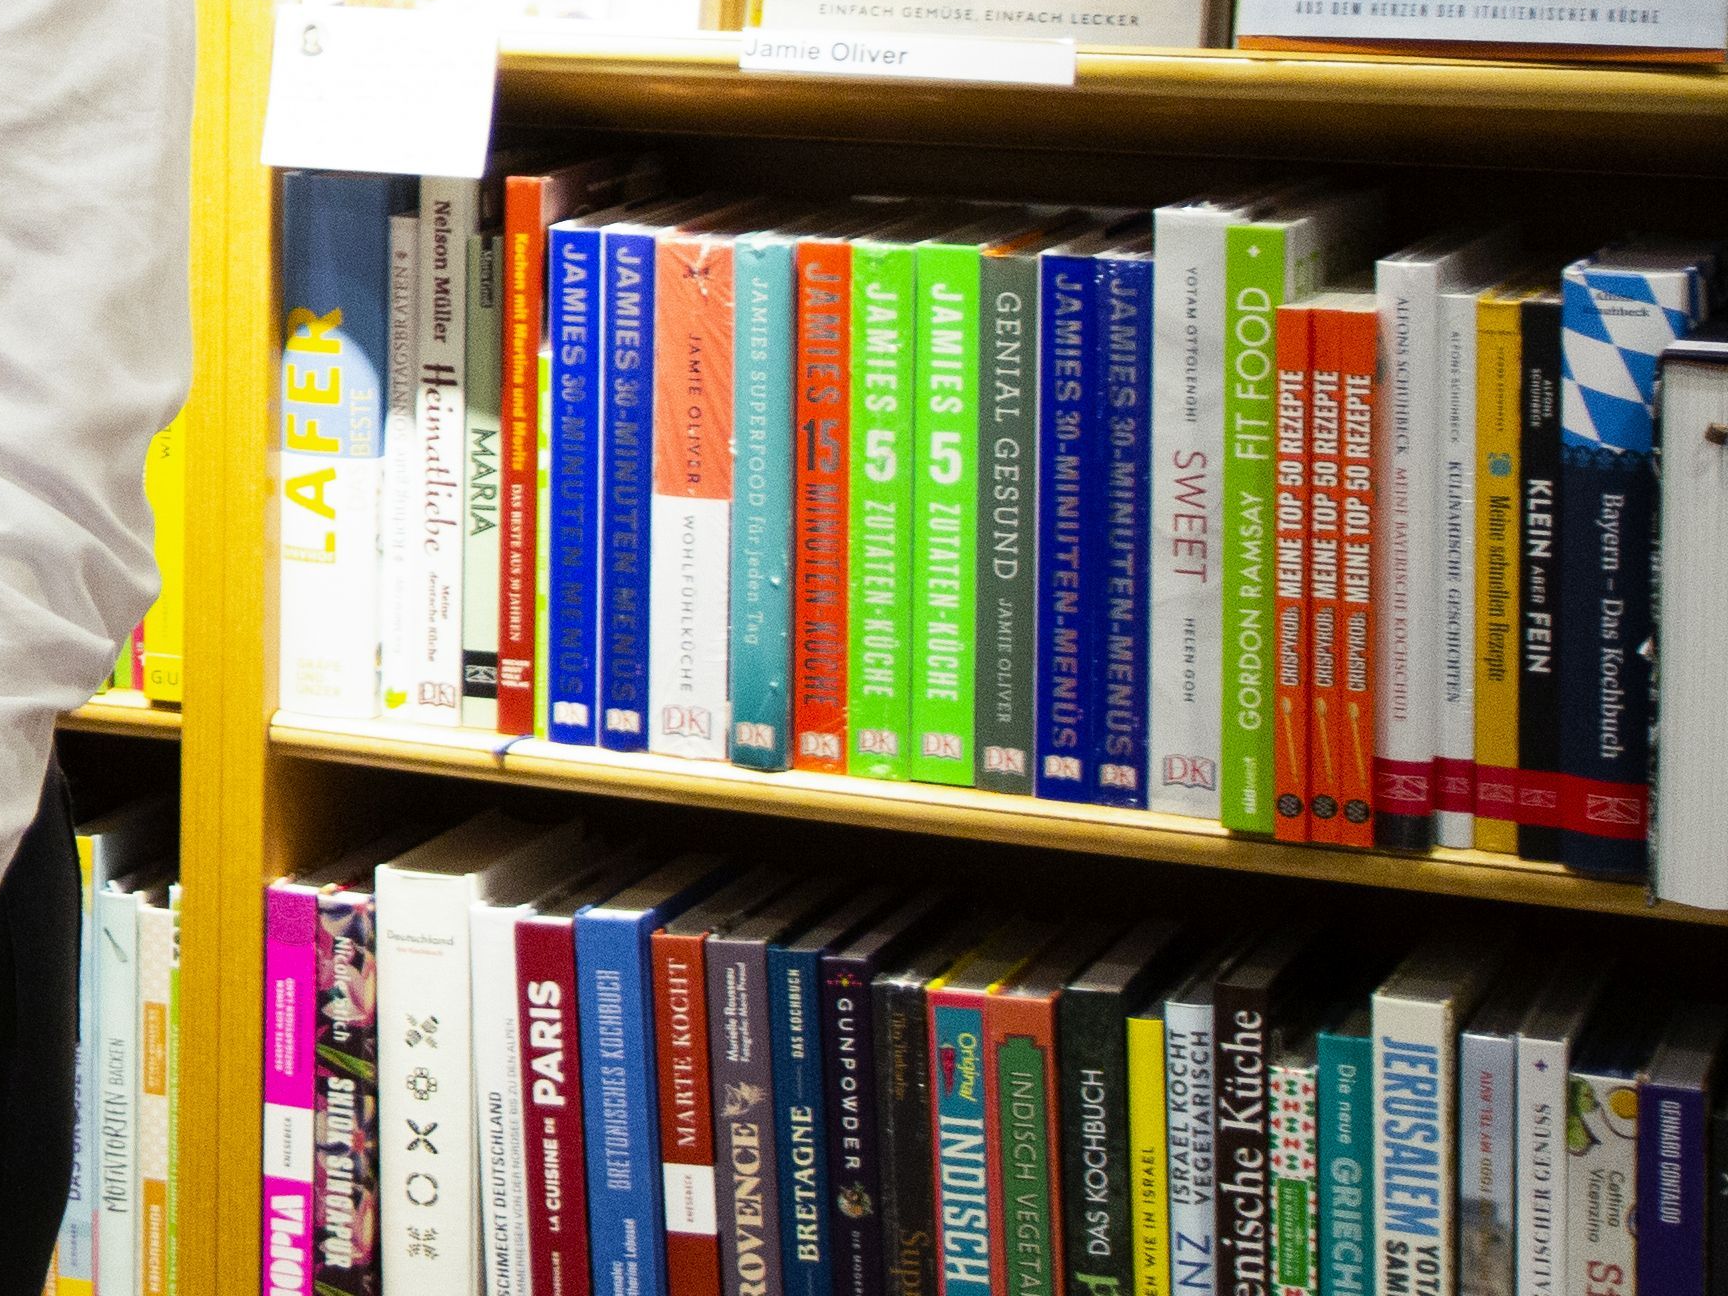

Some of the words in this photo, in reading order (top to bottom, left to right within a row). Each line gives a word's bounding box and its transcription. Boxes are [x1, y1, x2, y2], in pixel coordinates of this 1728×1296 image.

[818, 2, 896, 20] EINFACH
[984, 9, 1064, 27] EINFACH
[1070, 11, 1142, 28] LECKER
[1330, 0, 1363, 18] DEM
[1370, 0, 1431, 20] HERZEN
[1473, 3, 1601, 24] ITALIENISCHEN
[744, 38, 821, 64] Jamie
[830, 40, 909, 67] Oliver
[433, 200, 451, 273] Nelson
[512, 232, 529, 291] Kochen
[433, 277, 451, 345] Müller
[560, 241, 589, 368] JAMIES
[614, 245, 642, 373] JAMIES
[752, 277, 769, 361] JAMIES
[1186, 266, 1199, 312] YOTAM
[1395, 296, 1410, 353] ALFONS
[687, 333, 701, 397] JAMIE
[804, 263, 841, 406] JAMIES
[864, 281, 898, 415] JAMIES
[930, 283, 964, 416] JAMIES
[994, 291, 1022, 424] GENIAL
[1053, 273, 1084, 403] JAMIES
[1108, 279, 1139, 410] JAMIES
[1185, 315, 1198, 424] OTTOLENGHI
[1235, 286, 1273, 402] FOOD
[283, 305, 343, 570] LAFER
[750, 370, 767, 507] SUPERFOOD
[803, 417, 841, 473] 15
[1234, 405, 1269, 462] FIT
[1277, 368, 1305, 454] REZEPTE
[1312, 368, 1340, 456] REZEPTE
[1346, 372, 1373, 460] REZEPTE
[1394, 356, 1410, 456] SCHUHBECK
[421, 360, 458, 557] Heimatliebe
[469, 427, 499, 538] MARIA
[864, 430, 898, 483] 5
[929, 431, 964, 485] 5
[1279, 456, 1304, 488] 50
[1313, 457, 1340, 489] 50
[1346, 461, 1372, 493] 50
[1393, 466, 1409, 512] MEINE
[508, 512, 523, 548] BESTE
[749, 515, 765, 545] für
[992, 436, 1020, 582] GESUND
[1172, 450, 1208, 583] SWEET
[1238, 489, 1268, 602] RAMSAY
[1278, 491, 1304, 538] TOP
[1313, 491, 1339, 537] TOP
[1346, 495, 1371, 542] TOP
[1447, 460, 1464, 582] KULINARISCHE
[1488, 495, 1511, 542] Meine
[1527, 478, 1554, 558] KLEIN
[1598, 492, 1626, 573] Bayern
[680, 514, 697, 694] WOHLFÜHLKÜCHE
[745, 548, 764, 603] jeden
[861, 501, 897, 700] ZUTATEN-KÜCHE
[926, 502, 962, 704] ZUTATEN-KÜCHE
[1278, 539, 1304, 600] MEINE
[1312, 538, 1339, 601] MEINE
[1346, 543, 1371, 606] MEINE
[1391, 514, 1409, 614] BAYERISCHE
[1486, 545, 1511, 617] schnellen
[1530, 565, 1545, 604] ABER
[506, 592, 521, 641] JAHREN
[743, 610, 759, 646] Tag
[997, 597, 1014, 654] JAMIE
[1184, 617, 1197, 663] HELEN
[1446, 587, 1464, 703] GESCHICHTEN
[1484, 621, 1509, 682] Rezepte
[1527, 611, 1553, 674] FEIN
[1599, 597, 1624, 645] Das
[995, 659, 1012, 724] OLIVER
[1183, 668, 1196, 704] GOH
[1235, 607, 1265, 732] GORDON
[1597, 647, 1625, 760] Kochbuch
[385, 928, 455, 948] Deutschland
[595, 969, 622, 1060] KOCHBUCH
[667, 958, 694, 1049] KOCHT
[787, 967, 802, 1034] KOCHBUCH
[108, 1037, 127, 1088] BACKEN
[527, 980, 567, 1106] PARIS
[791, 1037, 804, 1059] DAS
[953, 1031, 977, 1104] Original
[1169, 1029, 1189, 1114] KOCHT
[1218, 1008, 1265, 1140] Küche
[677, 1055, 698, 1148] MARTE
[836, 997, 862, 1171] GUNPOWDER
[1189, 1029, 1213, 1205] VEGETARISCH
[486, 1090, 504, 1210] DEUTSCHLAND
[602, 1066, 631, 1191] BRETONISCHES
[1009, 1071, 1039, 1182] INDISCH
[1081, 1068, 1111, 1204] KOCHBUCH
[1171, 1121, 1191, 1205] ISRAEL
[1381, 1035, 1440, 1237] JERUSALEM
[1533, 1103, 1552, 1194] GENUSS
[1661, 1099, 1681, 1160] GENNARO
[323, 1153, 356, 1270] SINGAPUR
[544, 1138, 561, 1212] CUISINE
[790, 1104, 820, 1262] BRETAGNE
[941, 1115, 991, 1287] INDISCH
[1585, 1166, 1608, 1245] Vicenzino
[1659, 1161, 1680, 1225] CONTALDO
[1087, 1208, 1113, 1257] DAS
